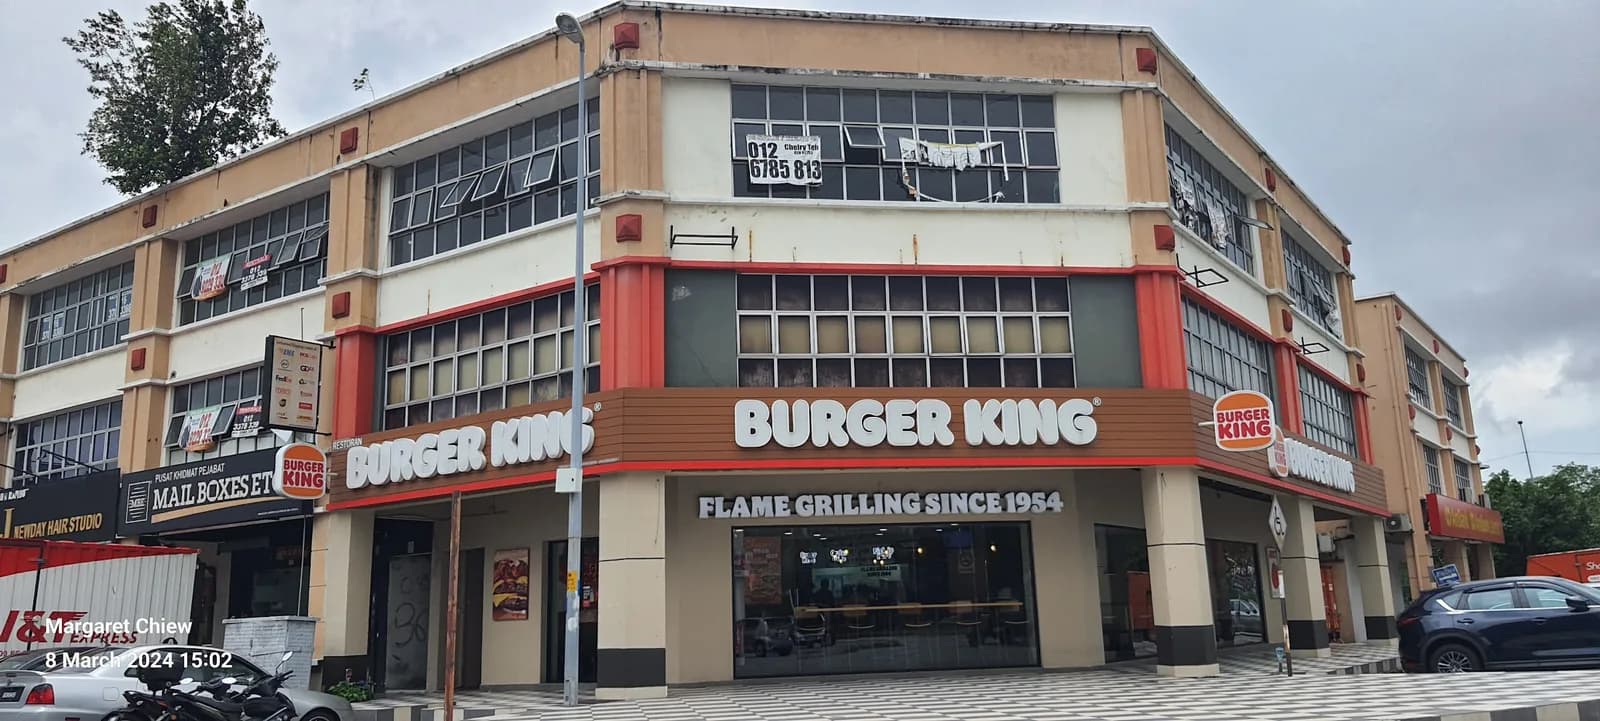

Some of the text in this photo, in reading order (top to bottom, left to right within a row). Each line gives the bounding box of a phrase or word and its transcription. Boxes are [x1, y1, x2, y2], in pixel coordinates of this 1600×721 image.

[748, 142, 778, 159] 012
[750, 159, 822, 180] 6785 813
[734, 398, 1097, 448] BURGER KING
[1217, 408, 1270, 424] BURGER
[1217, 420, 1272, 440] KING
[333, 438, 363, 450] RESTORAN
[346, 407, 595, 490] BURGER KING
[155, 463, 225, 483] PUSAT KHIDMAT PEJABAT
[284, 460, 324, 473] BURGER
[283, 471, 324, 488] KING
[153, 485, 195, 511] MAIL
[198, 475, 250, 506] BOXES
[699, 490, 1063, 519] FLAME GRILLING SINCE 1954
[14, 512, 103, 539] NEWDAY HAIR STUDIO
